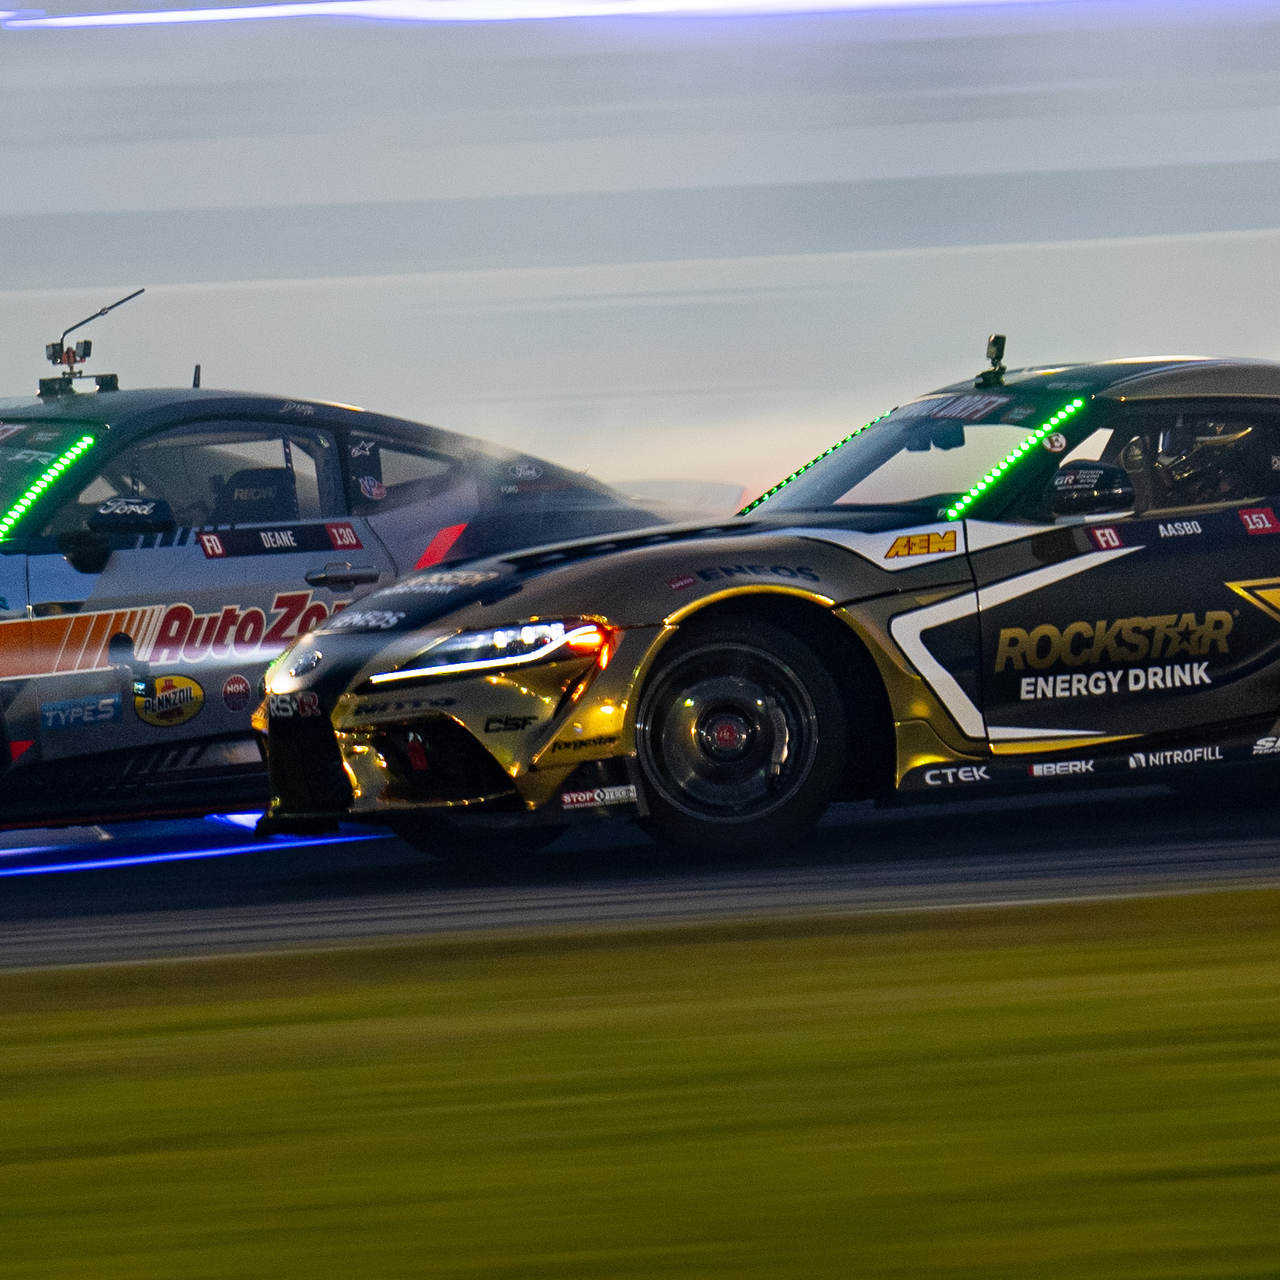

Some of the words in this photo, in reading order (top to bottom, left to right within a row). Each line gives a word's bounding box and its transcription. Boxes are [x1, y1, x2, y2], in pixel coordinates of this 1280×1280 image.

[98, 498, 156, 516] Ford
[203, 533, 223, 555] FD
[260, 531, 296, 549] DEANE
[333, 527, 356, 545] 130
[884, 530, 957, 559] AEM
[1095, 527, 1120, 548] FD
[1158, 520, 1202, 538] AASBO
[1244, 513, 1272, 530] 151
[150, 590, 349, 665] AutoZo
[995, 610, 1233, 672] ROCKSTAR
[1020, 671, 1123, 701] ENERGY
[1128, 662, 1211, 691] DRINK
[144, 686, 192, 715] PENNZOIL
[1043, 760, 1095, 776] BERK
[1149, 747, 1224, 767] NITROFILL
[925, 766, 990, 785] CTEK
[563, 792, 593, 803] STOP
